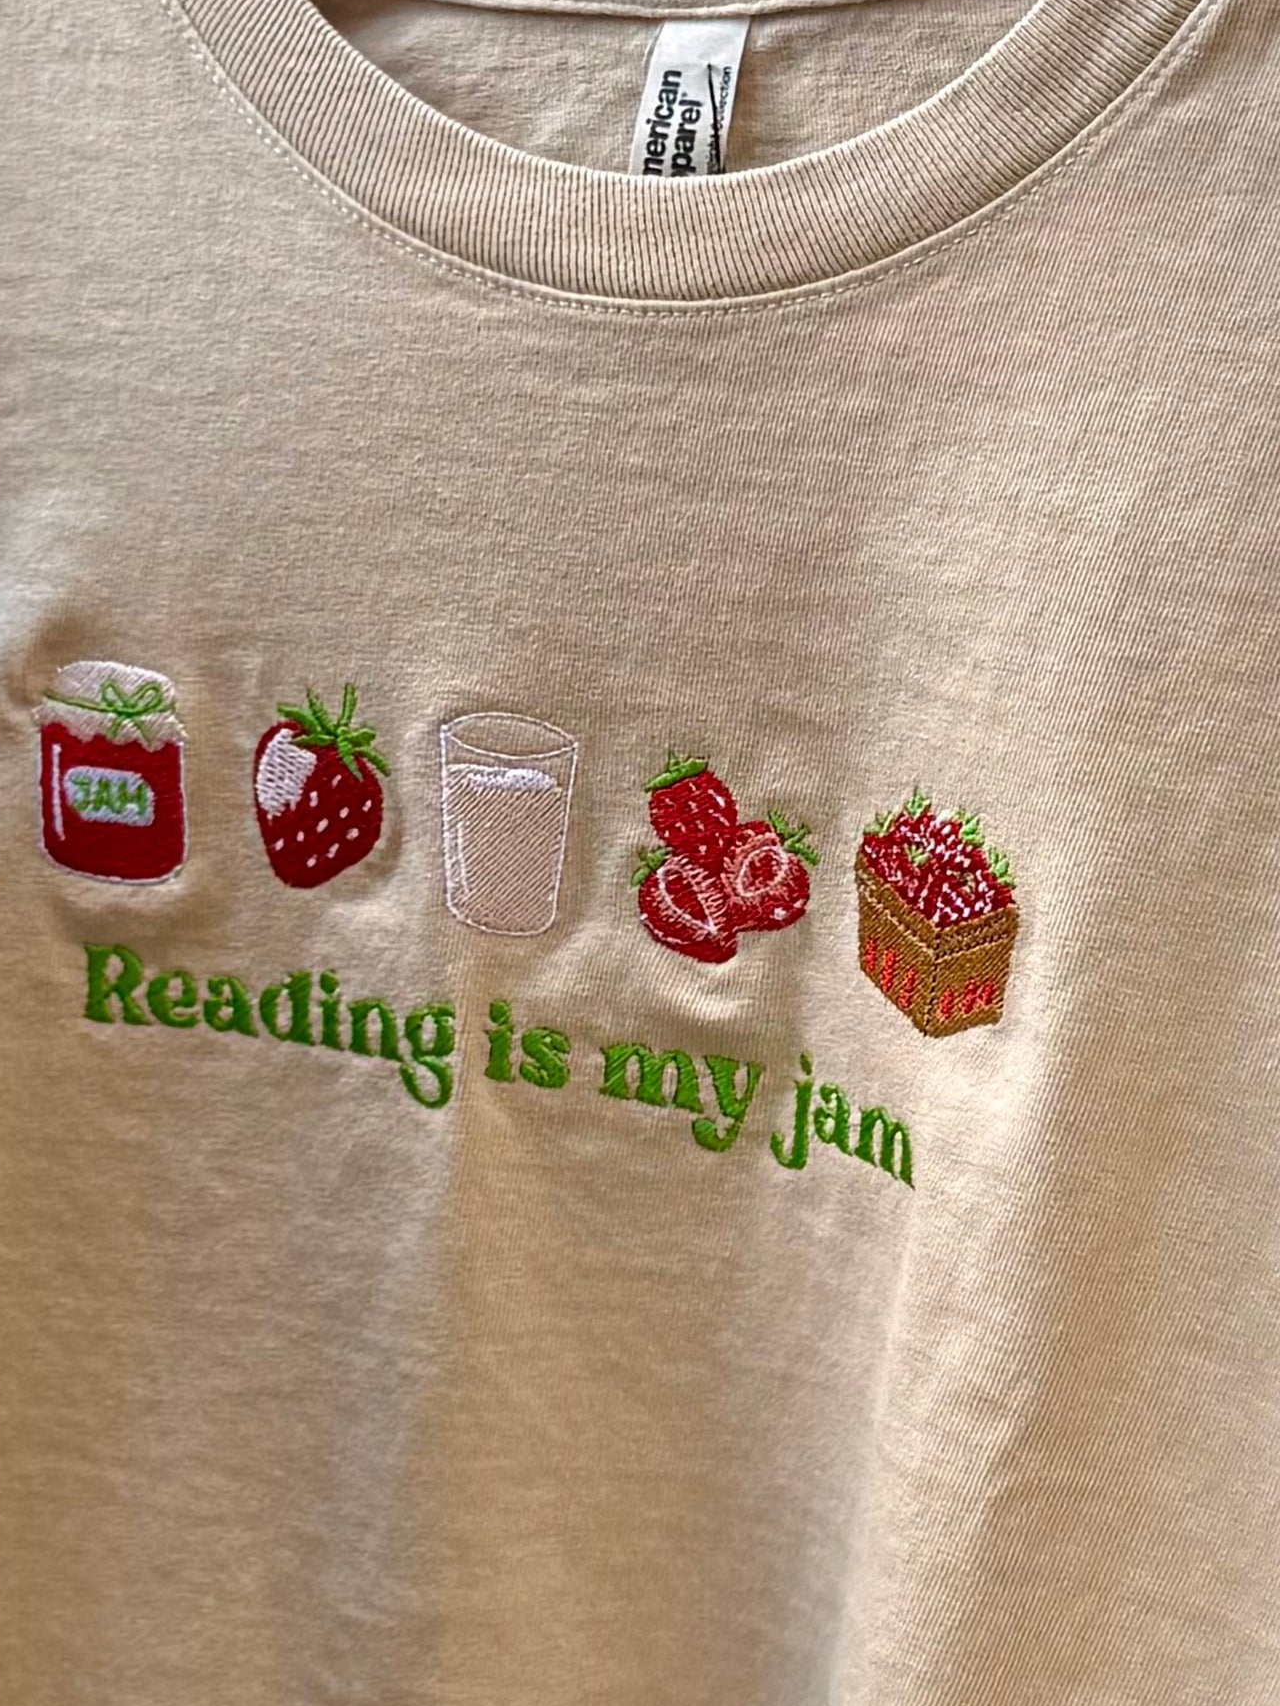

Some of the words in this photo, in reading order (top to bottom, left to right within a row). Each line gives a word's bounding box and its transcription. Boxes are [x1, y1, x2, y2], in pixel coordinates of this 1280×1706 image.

[642, 70, 682, 176] merican
[70, 775, 148, 816] JAM
[82, 943, 456, 1110] Reading
[485, 998, 572, 1090] is
[601, 1041, 762, 1153] my
[769, 1053, 915, 1188] jam
